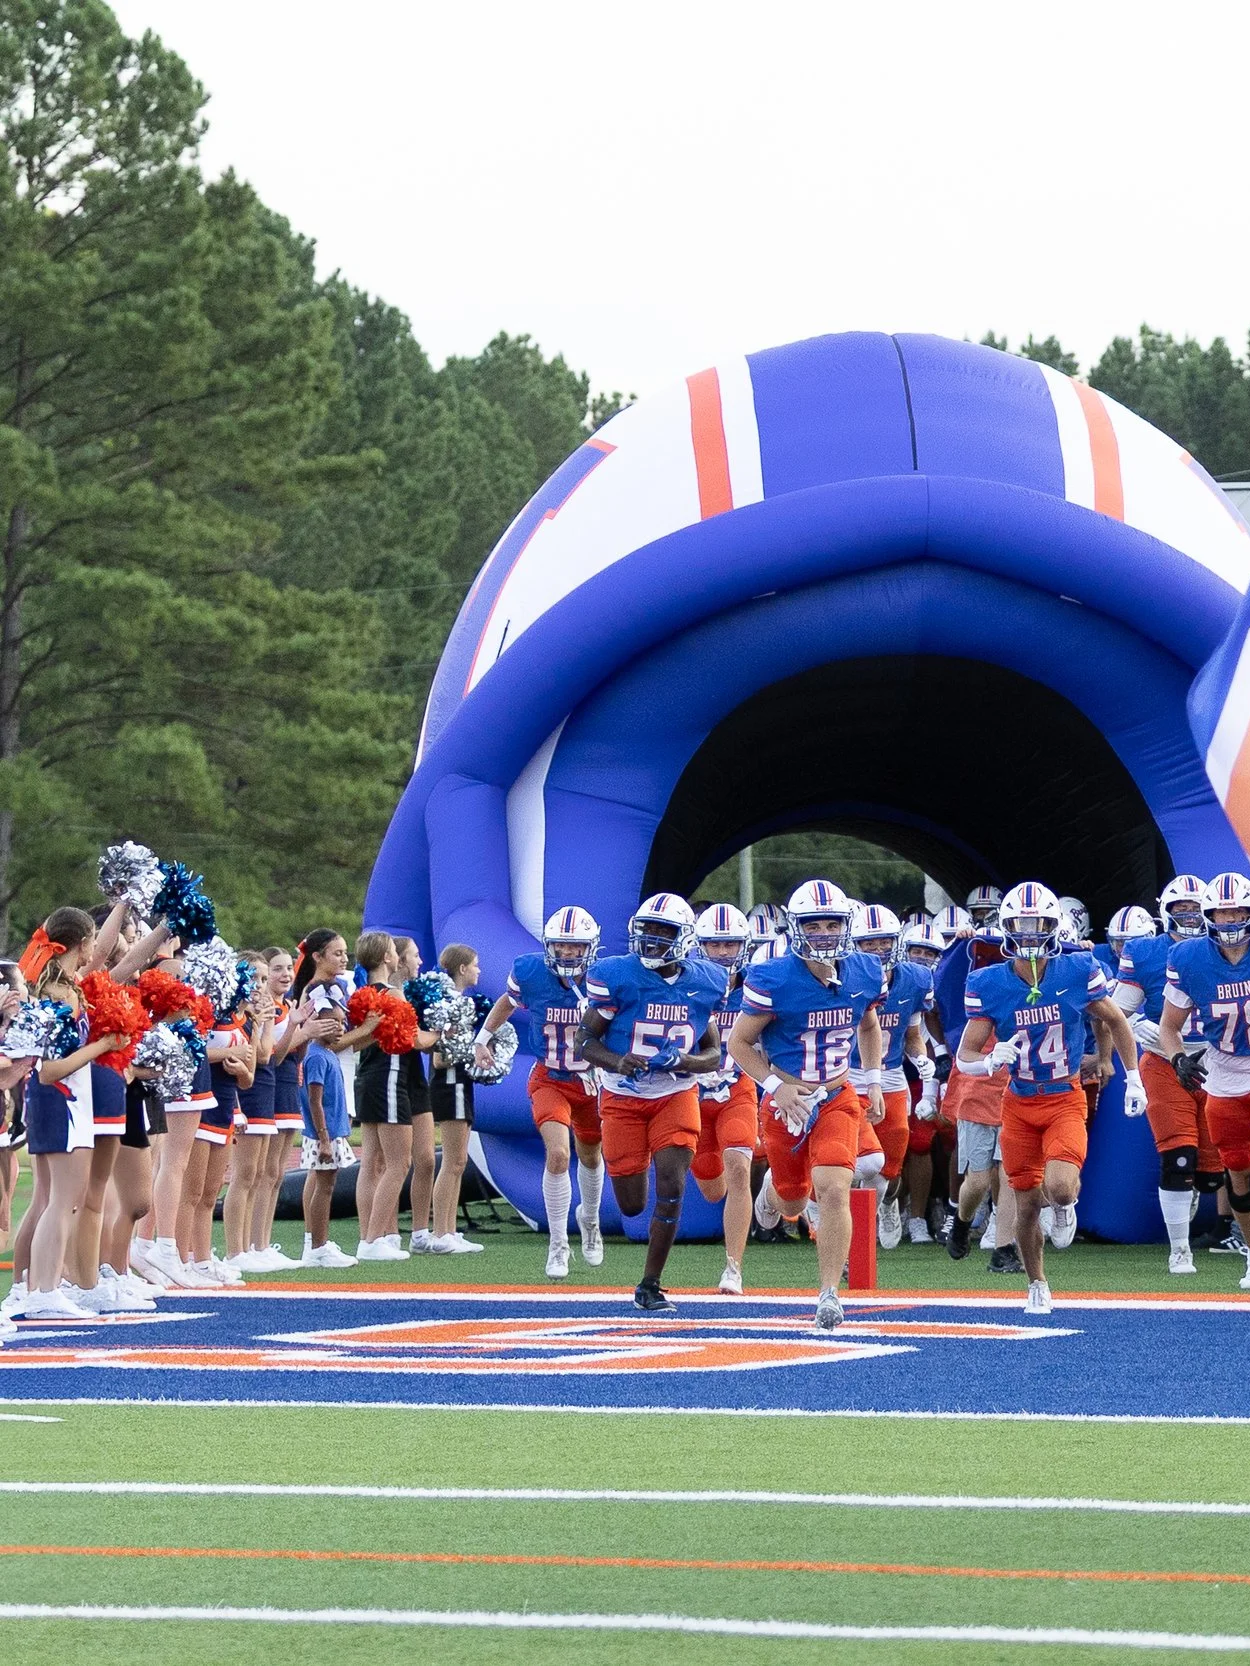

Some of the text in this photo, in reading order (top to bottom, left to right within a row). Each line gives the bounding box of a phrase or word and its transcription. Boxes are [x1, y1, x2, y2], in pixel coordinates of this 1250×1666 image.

[546, 1007, 583, 1024] BRUIN
[646, 1003, 688, 1022] BRUINS
[808, 1008, 853, 1028] BRUINS
[1015, 1003, 1061, 1026] BRUINS
[800, 1028, 855, 1083] 12
[1015, 1022, 1069, 1082] 14
